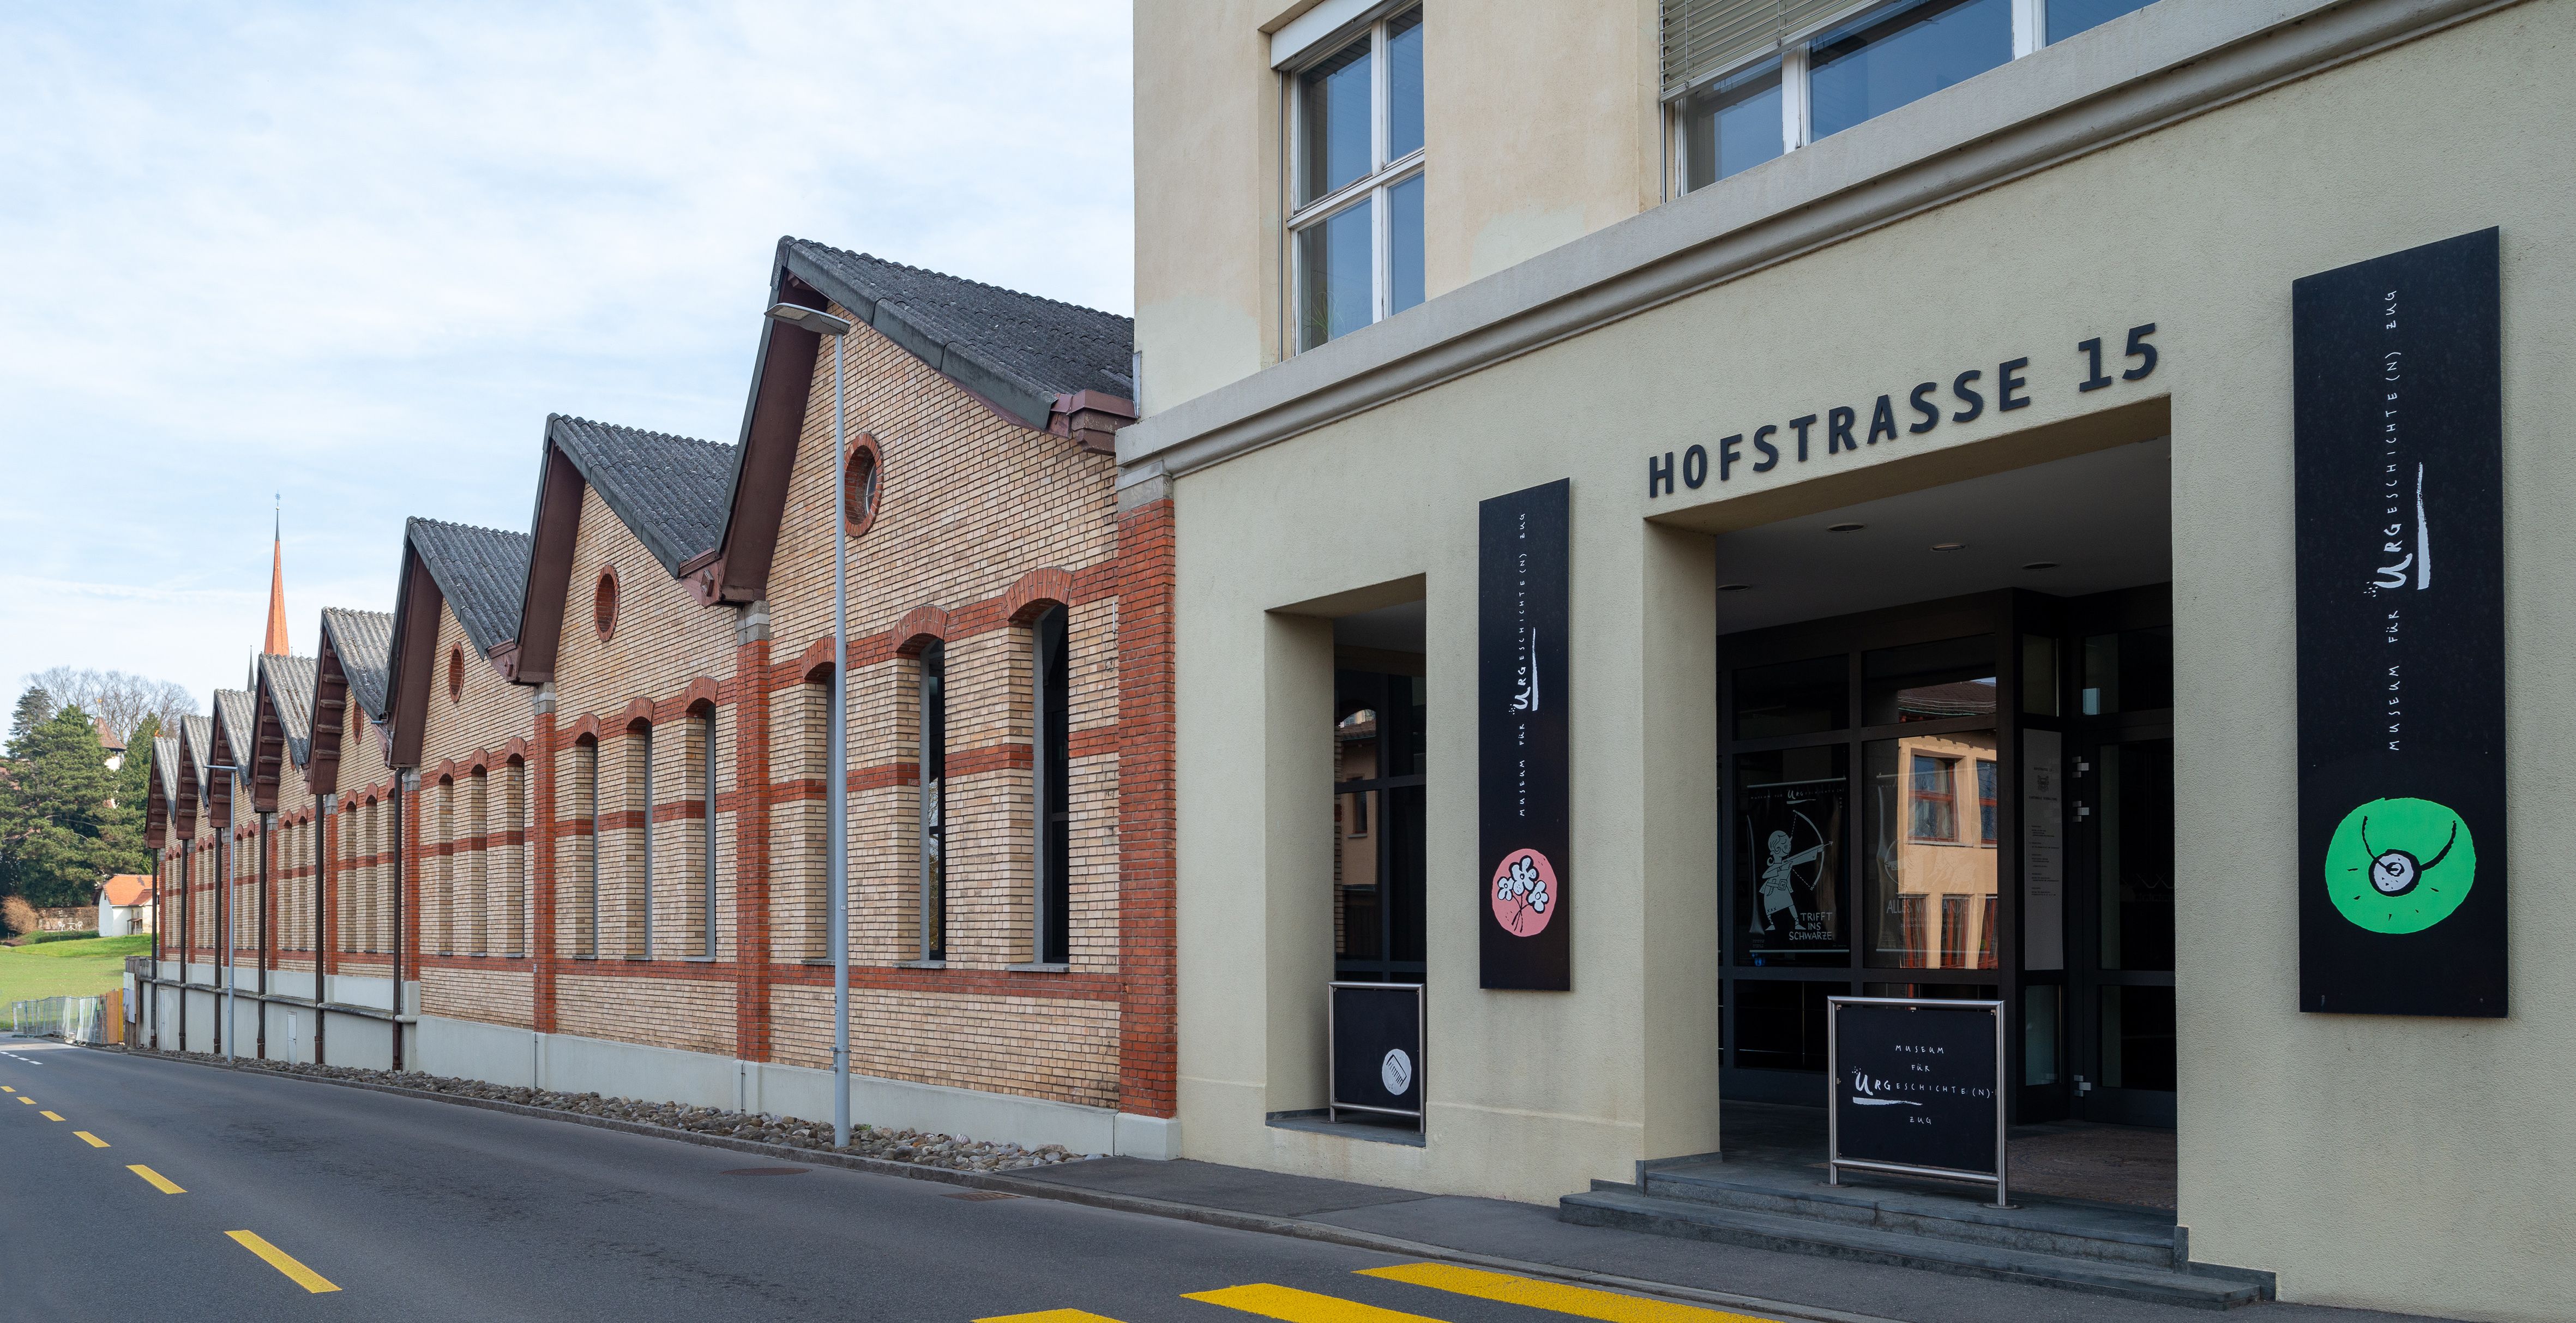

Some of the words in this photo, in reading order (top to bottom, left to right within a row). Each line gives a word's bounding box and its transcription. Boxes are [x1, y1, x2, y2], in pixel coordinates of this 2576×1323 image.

[2385, 290, 2397, 330] ZUG
[1649, 356, 2031, 498] HOFSTRASSE
[2078, 322, 2158, 393] 15
[2385, 610, 2400, 643] FÜR
[2388, 665, 2400, 750] MUSEUM
[1886, 899, 1912, 914] ALLES
[1800, 912, 1833, 921] TRIFFT
[1808, 922, 1821, 931] INS
[1789, 931, 1832, 941] SCHWARZE
[1895, 1045, 1944, 1054] MUSEUM
[1911, 1064, 1930, 1072] FÜR
[1910, 1116, 1931, 1125] ZUG
